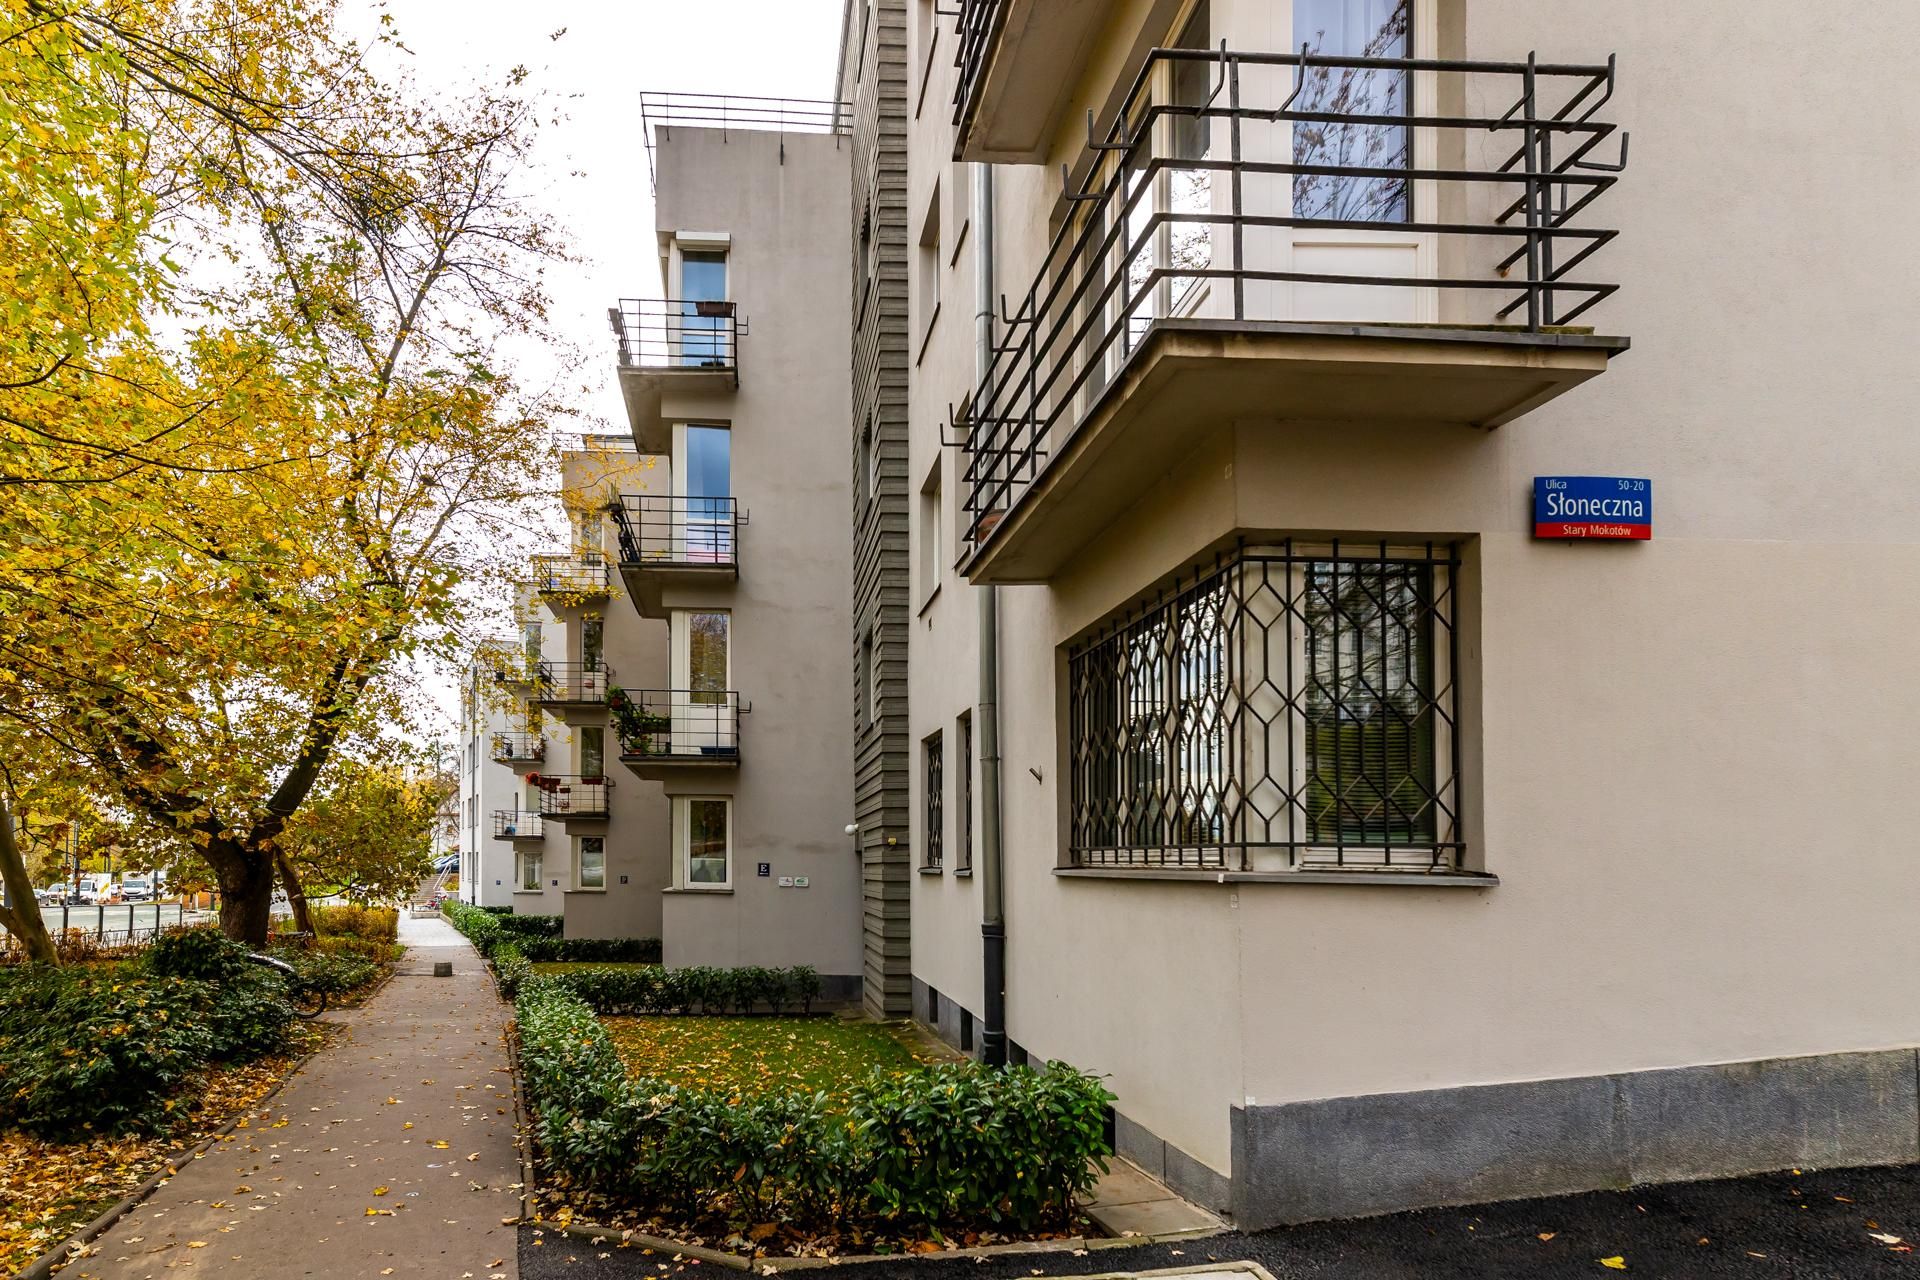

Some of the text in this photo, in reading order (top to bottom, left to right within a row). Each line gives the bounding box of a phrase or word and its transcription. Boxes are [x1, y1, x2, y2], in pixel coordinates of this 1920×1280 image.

[1545, 479, 1567, 490] Ulica
[1618, 480, 1644, 491] 50-20
[1547, 492, 1643, 517] Słoneczna
[1563, 524, 1632, 537] Stary Mokotów
[760, 864, 768, 872] E
